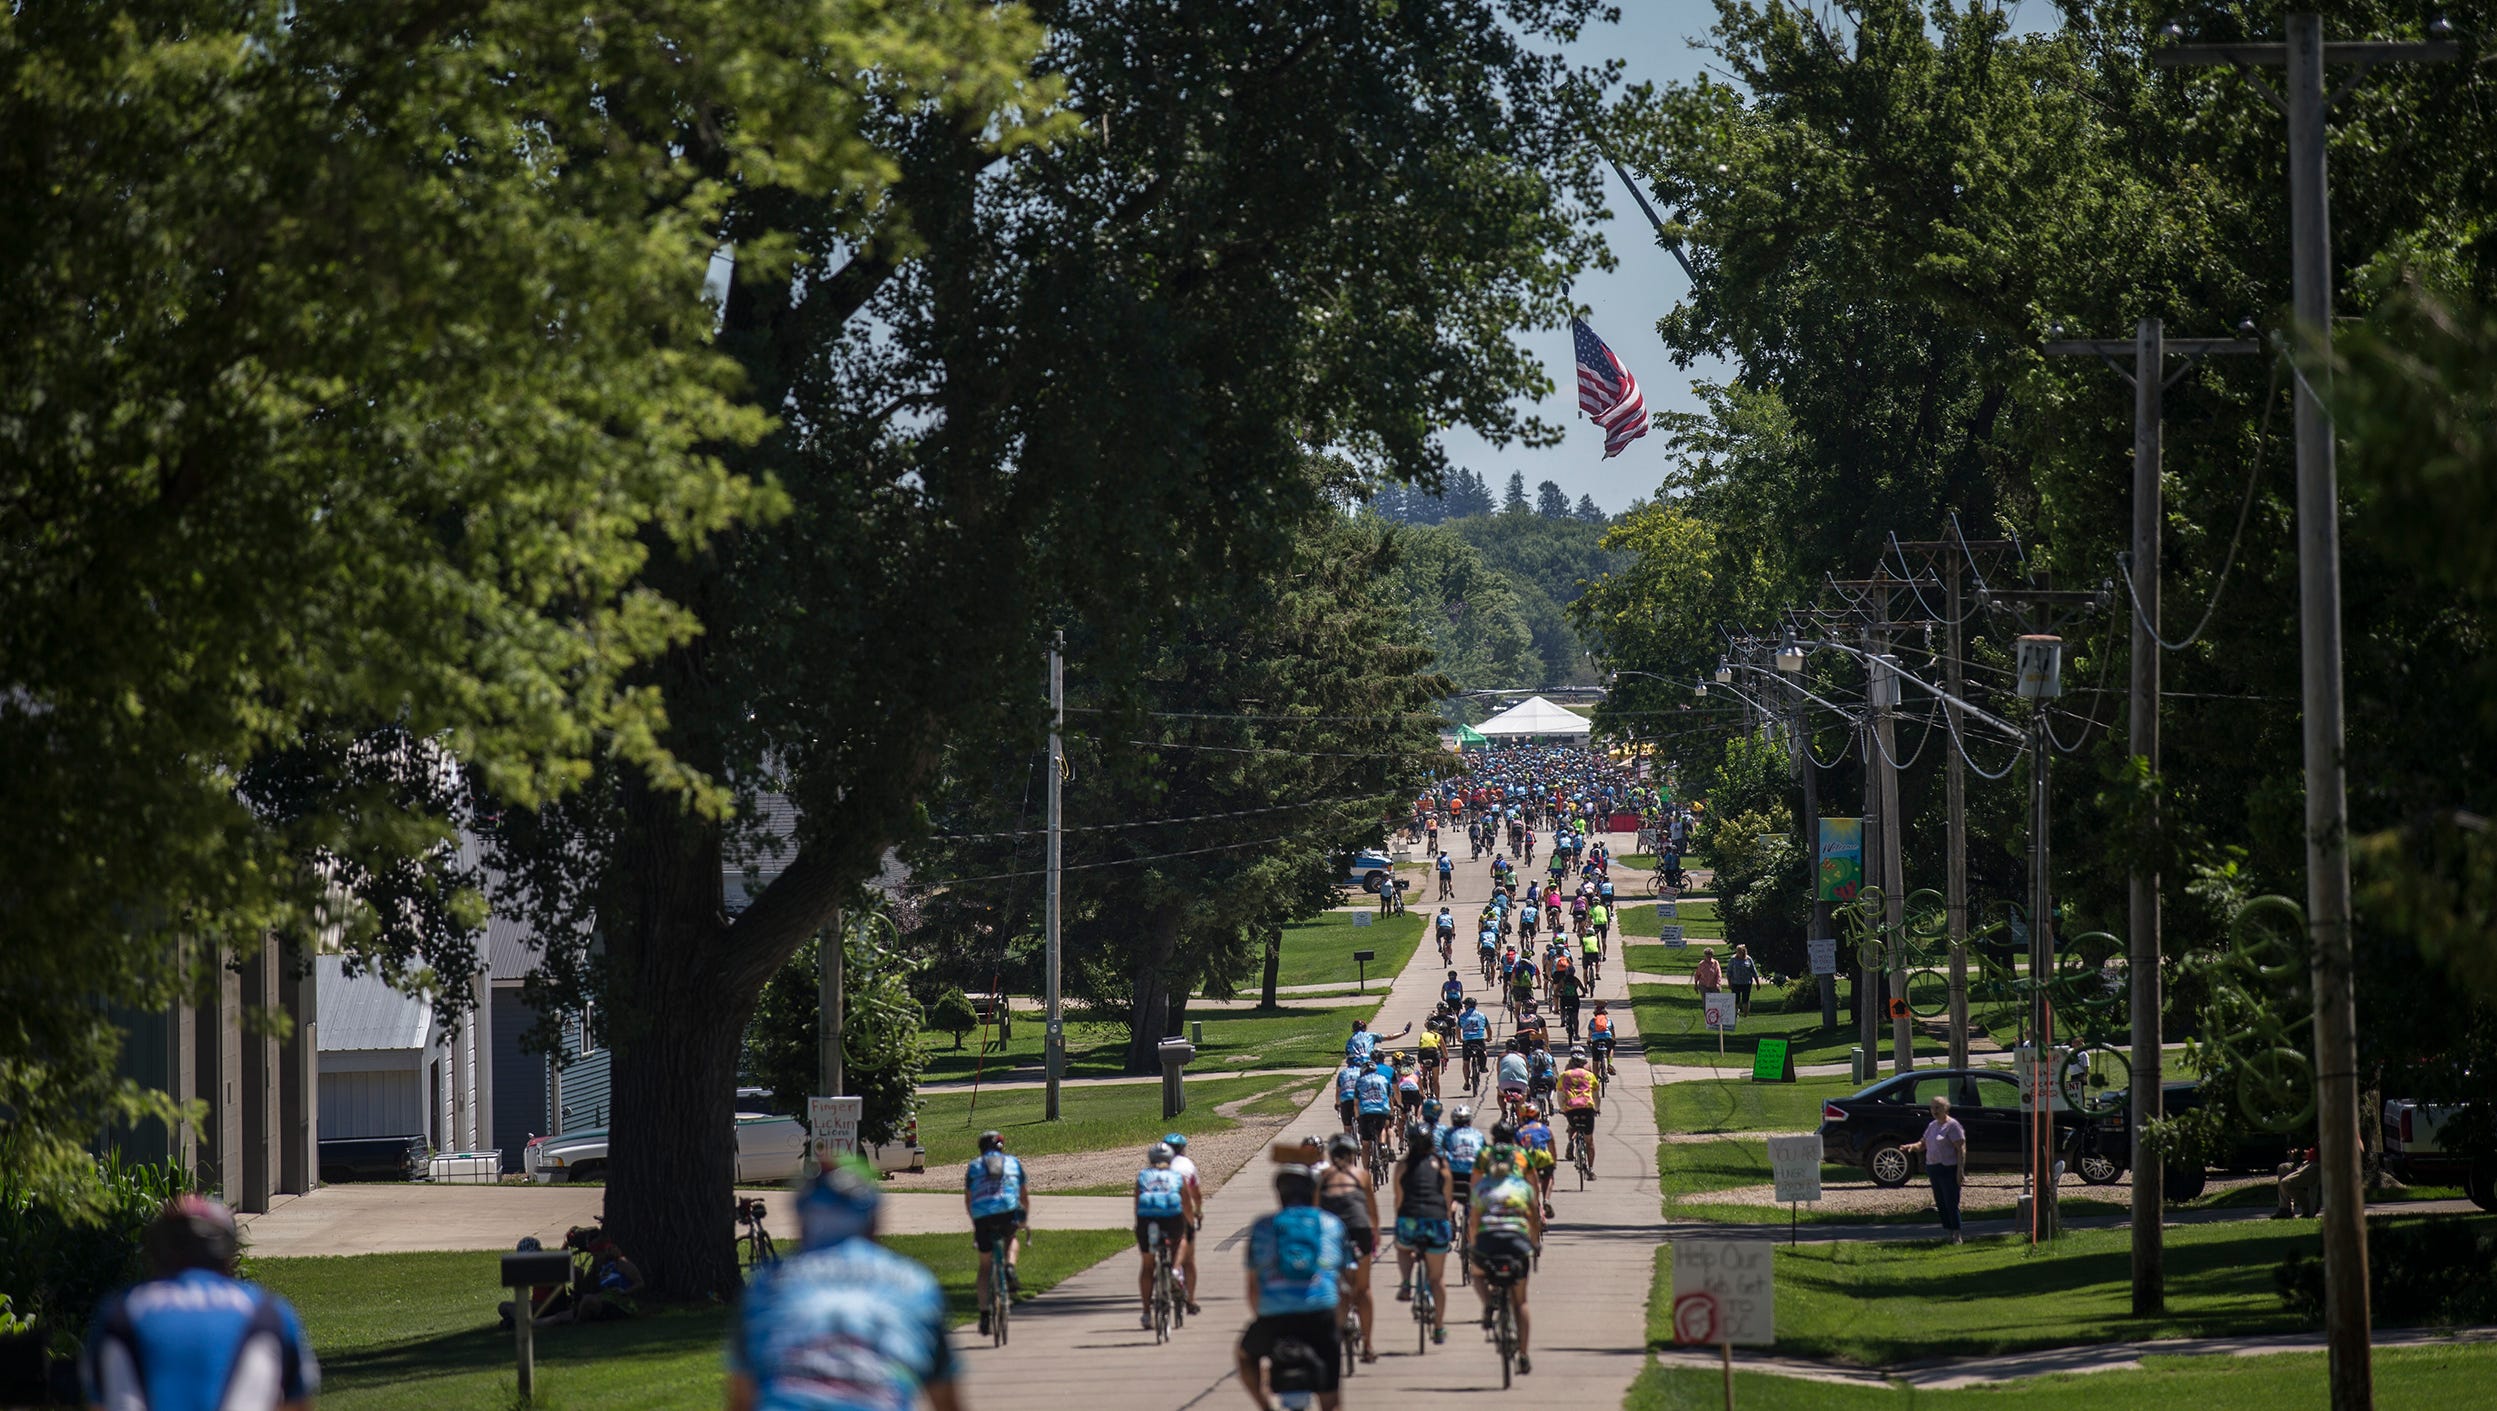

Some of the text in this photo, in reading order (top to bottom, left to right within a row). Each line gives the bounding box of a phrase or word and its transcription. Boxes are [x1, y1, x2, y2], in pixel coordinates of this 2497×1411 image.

[811, 1099, 856, 1115] Finger
[1771, 1139, 1797, 1161] YOU
[1677, 1243, 1762, 1272] Help Our
